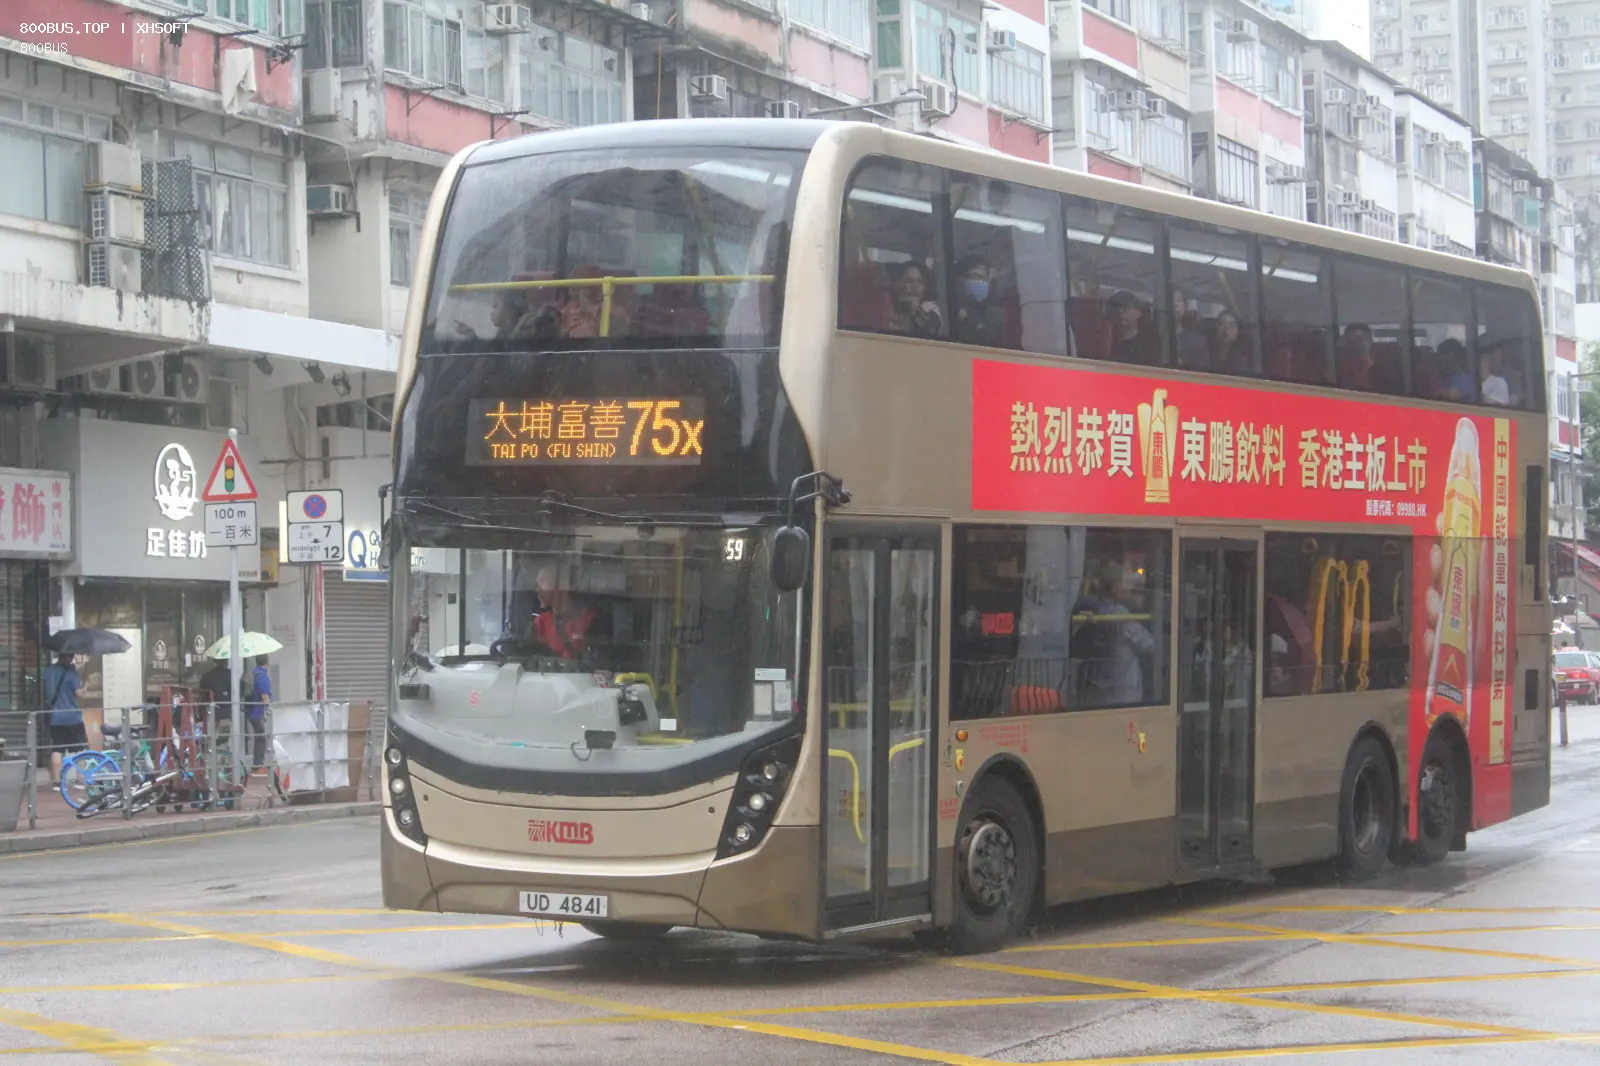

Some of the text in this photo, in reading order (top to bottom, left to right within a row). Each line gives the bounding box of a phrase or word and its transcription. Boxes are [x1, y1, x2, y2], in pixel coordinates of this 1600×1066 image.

[484, 400, 626, 440] 大埔富善
[1010, 400, 1134, 478] 熱烈恭賀
[491, 443, 616, 459] TAI PO (FU SHIN)
[1180, 416, 1427, 494] 東鵬飲料 香港主板上市
[0, 482, 46, 544] 飾
[214, 508, 246, 519] 100 m
[210, 524, 252, 540] 一百米
[323, 525, 331, 538] 7
[324, 546, 340, 558] 12
[727, 539, 743, 560] 59
[546, 820, 594, 845] KMB
[526, 893, 600, 915] UD 4841
